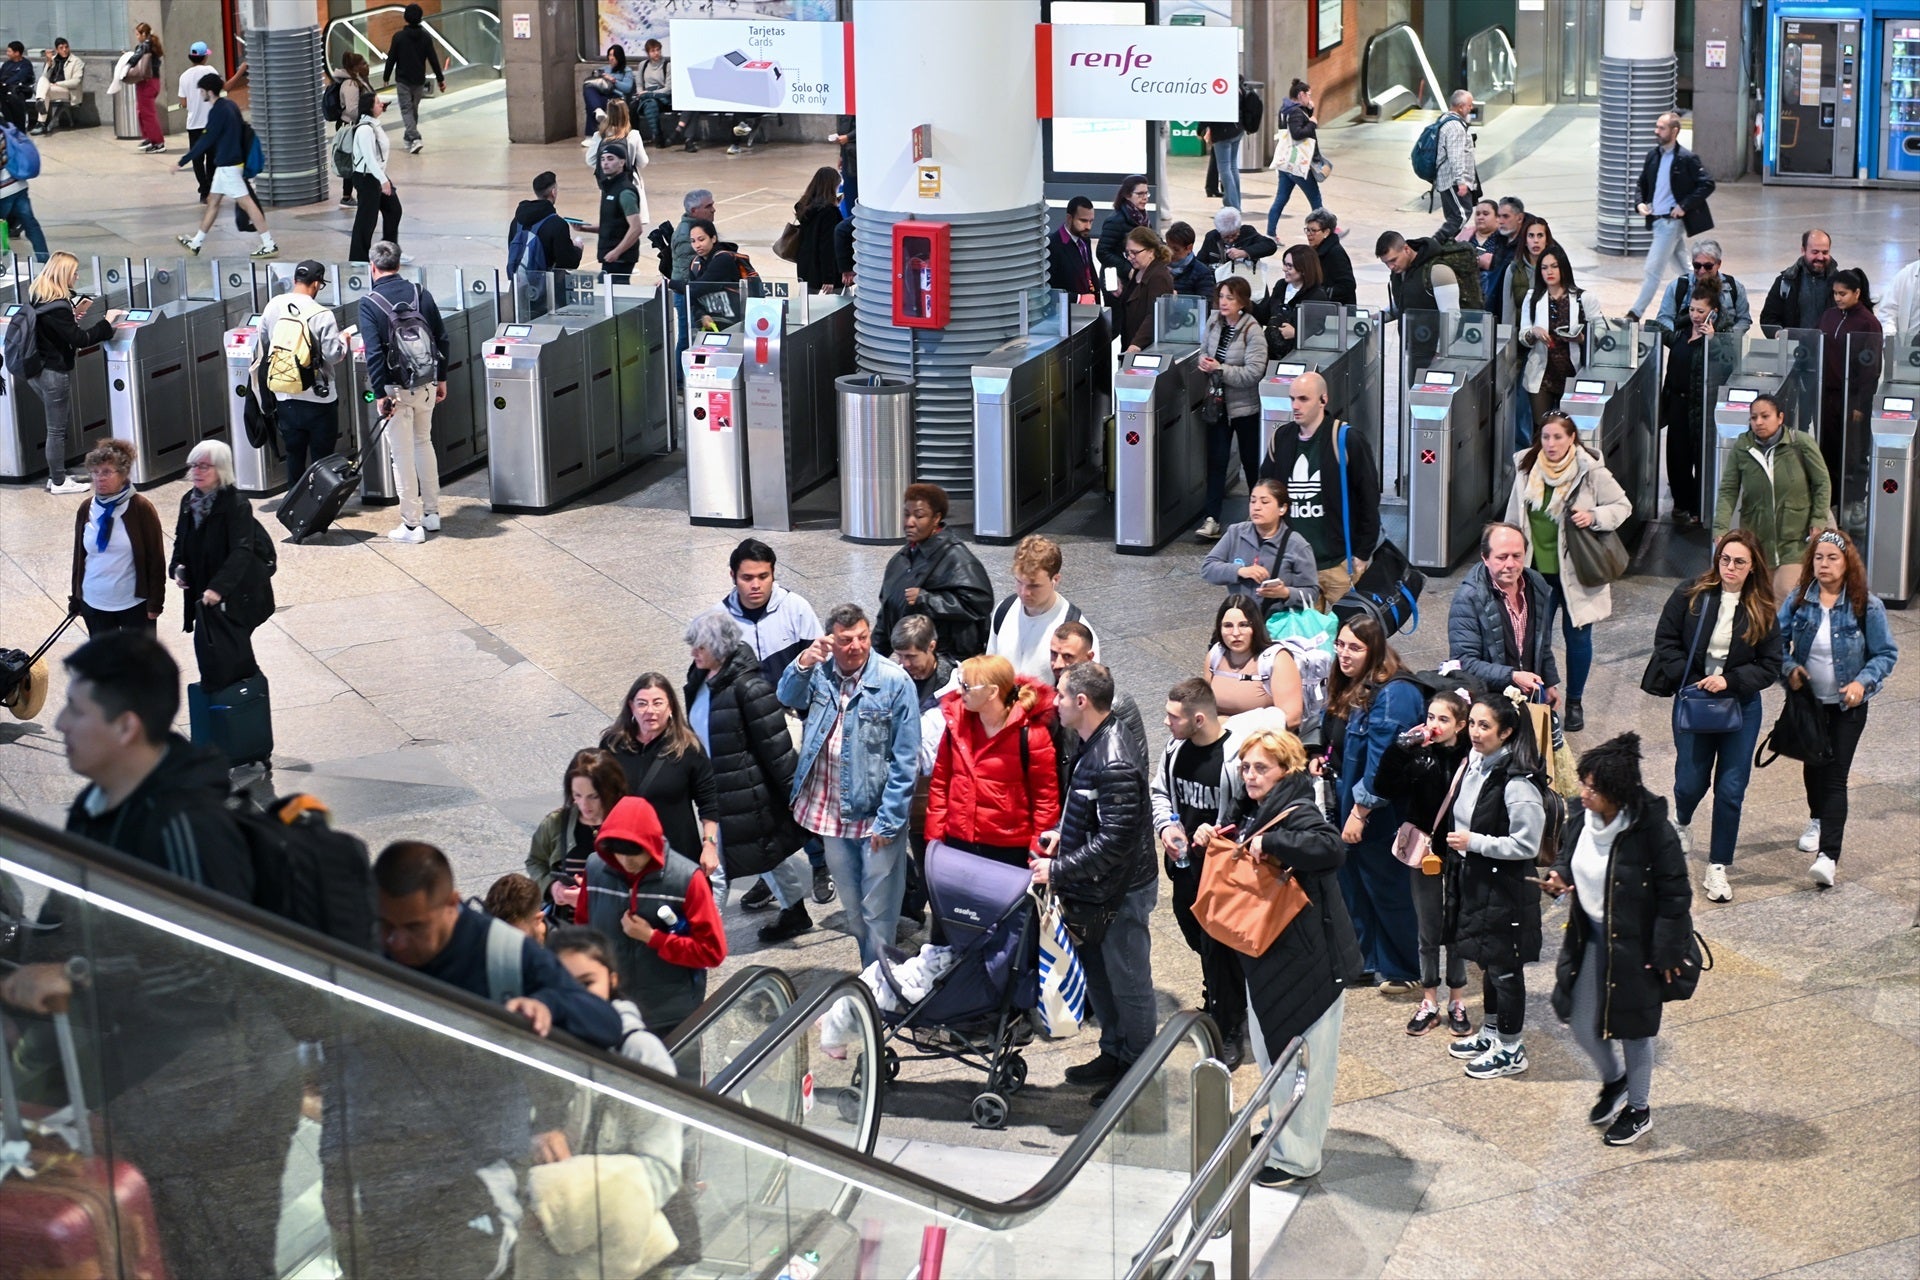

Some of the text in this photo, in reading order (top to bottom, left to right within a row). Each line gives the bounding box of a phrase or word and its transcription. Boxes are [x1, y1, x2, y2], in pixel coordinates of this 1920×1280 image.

[749, 26, 785, 37] Tarjetas
[749, 37, 773, 46] Cards
[1070, 44, 1153, 76] renfe
[792, 83, 830, 94] Solo QR
[1131, 77, 1207, 94] Cercanías
[792, 94, 828, 106] QR only
[1172, 129, 1198, 137] DEA
[1127, 413, 1137, 421] 35
[1423, 431, 1434, 439] 37
[1885, 459, 1896, 468] 40
